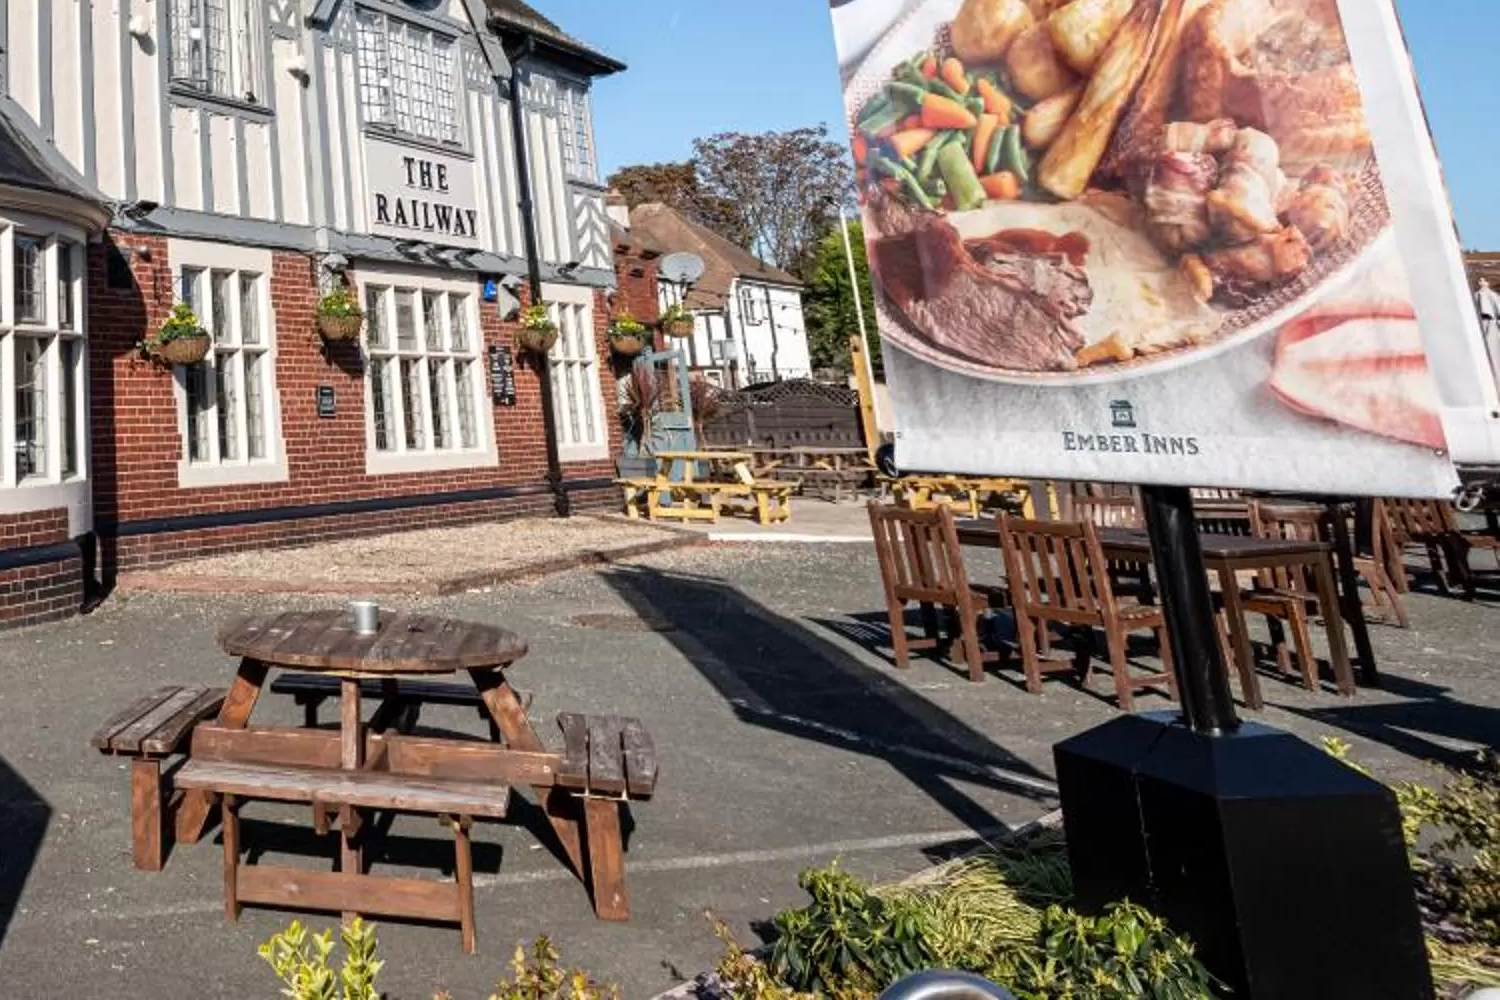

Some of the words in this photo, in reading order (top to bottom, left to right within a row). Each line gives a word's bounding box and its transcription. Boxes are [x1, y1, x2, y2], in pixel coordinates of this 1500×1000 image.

[403, 156, 449, 190] THE
[375, 193, 477, 237] RAILWAY
[1062, 431, 1139, 453] EMBER
[1141, 433, 1199, 455] INNS
